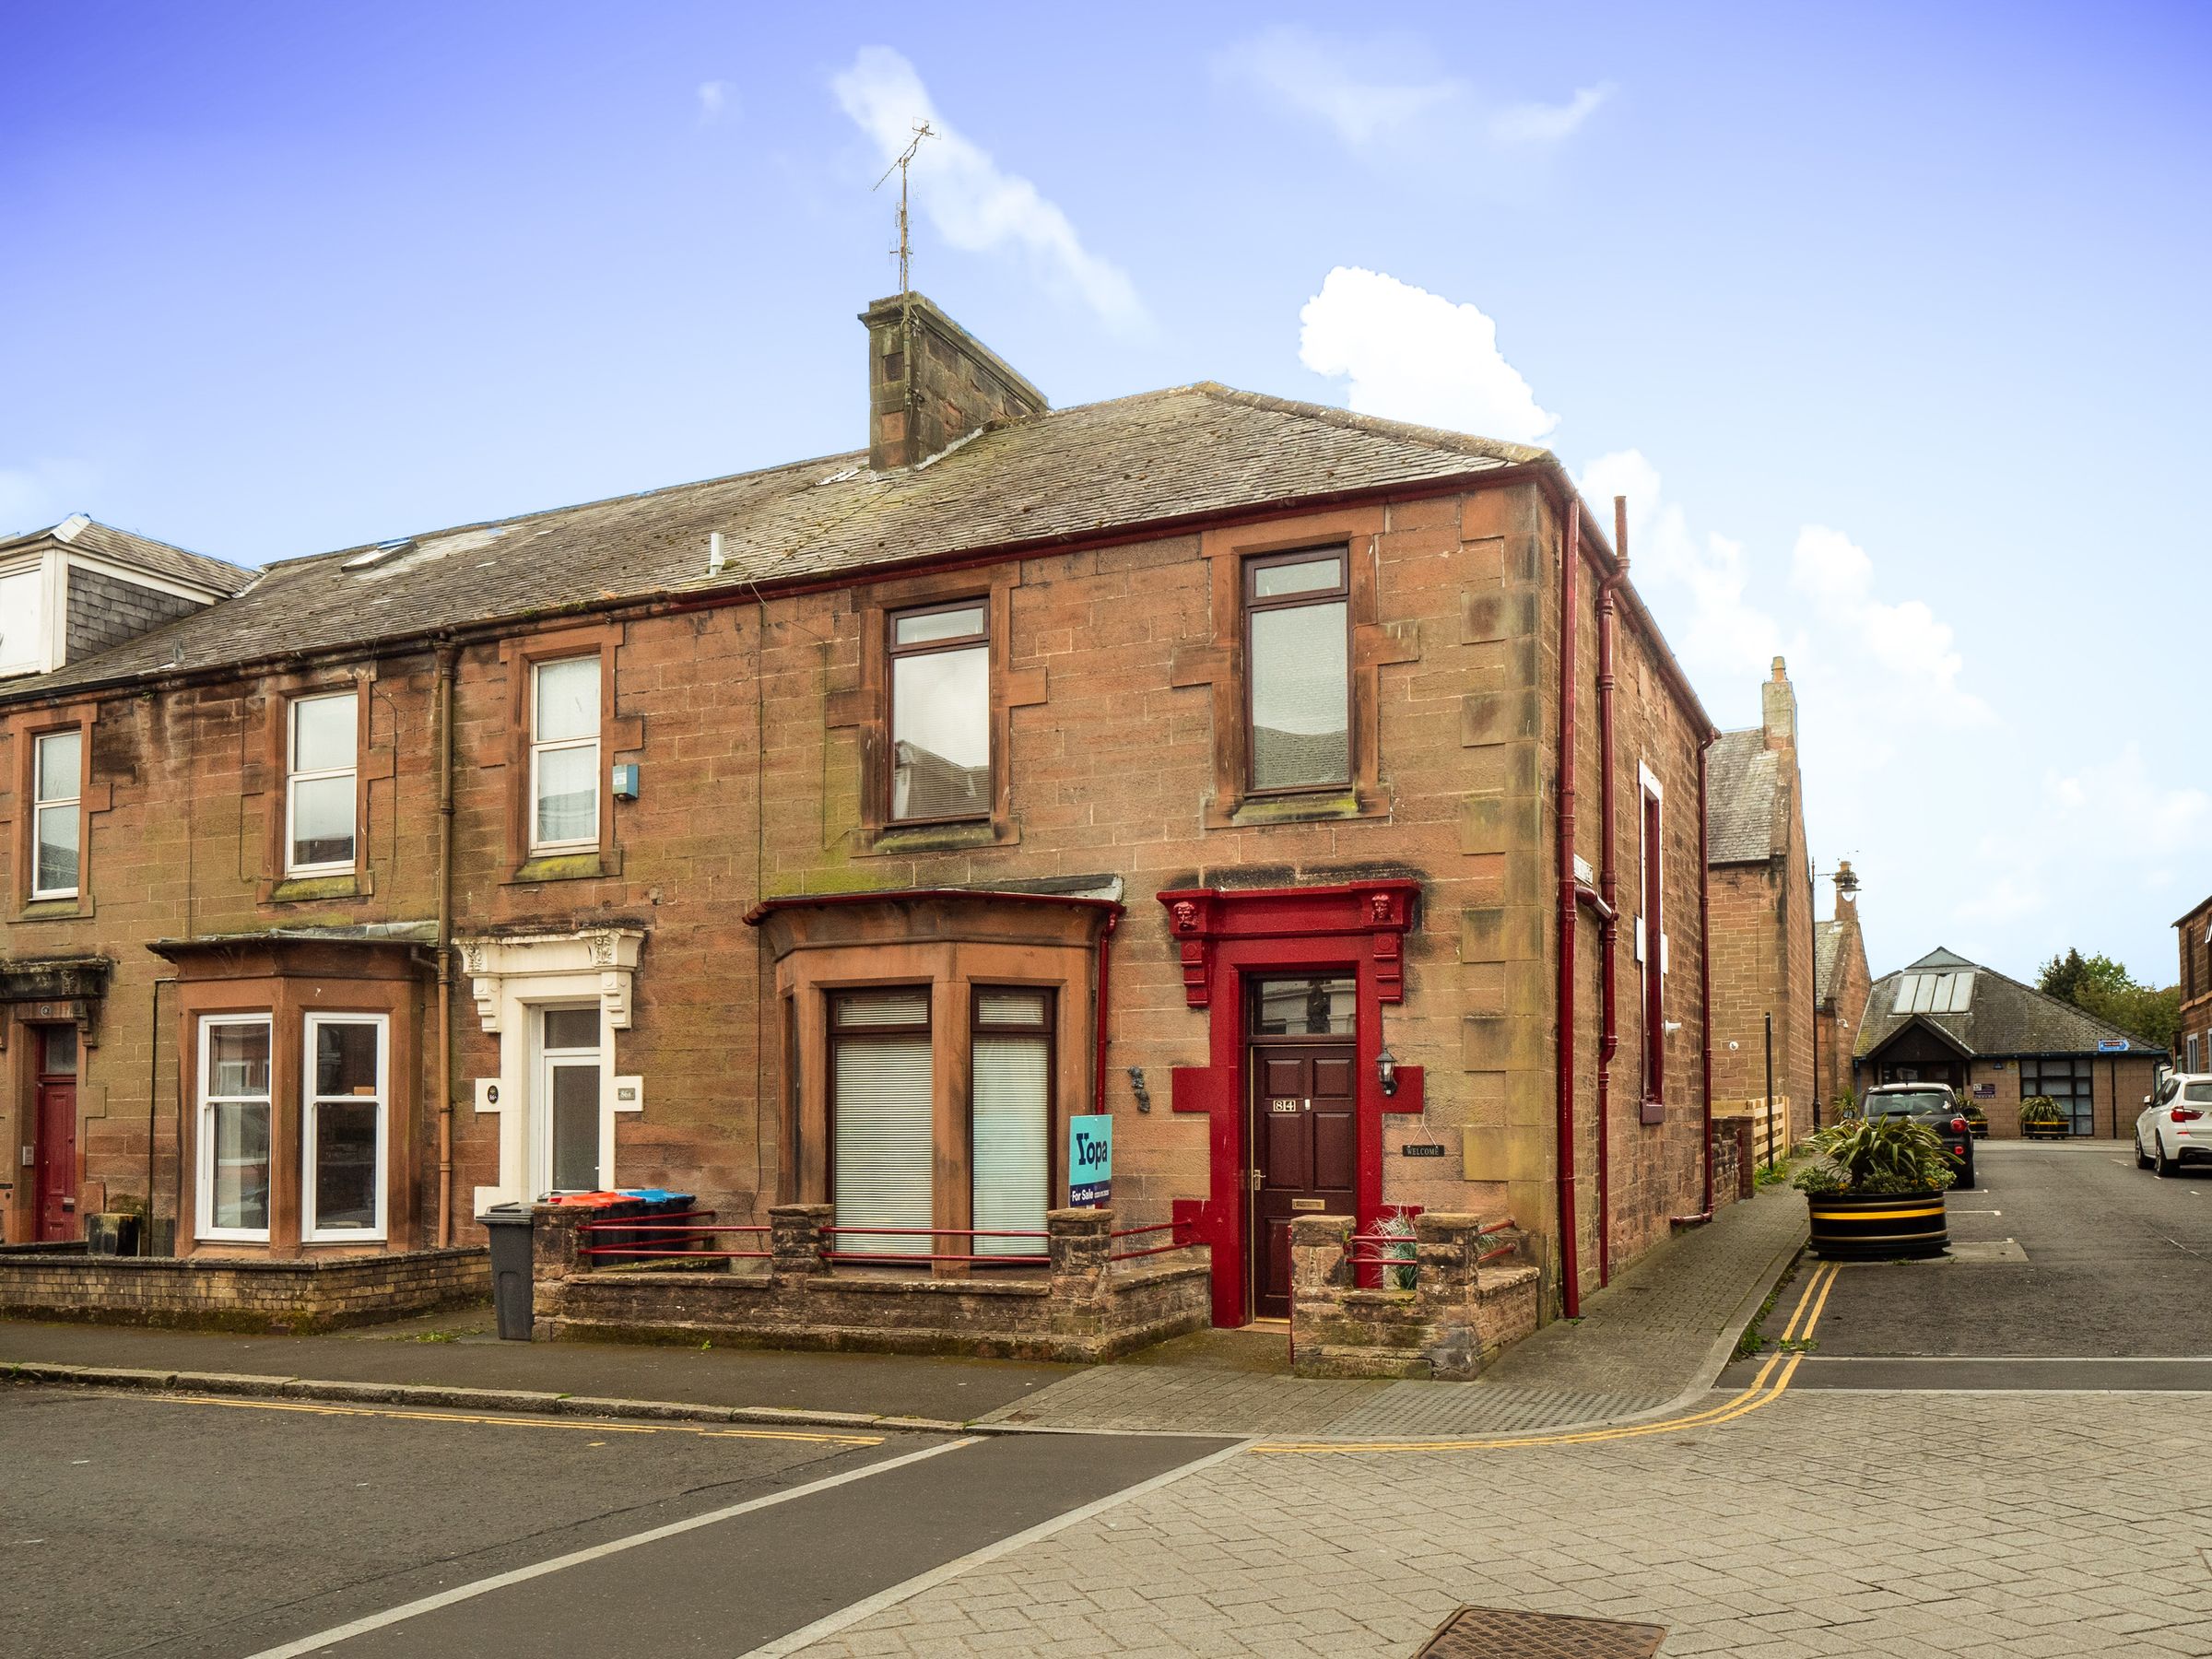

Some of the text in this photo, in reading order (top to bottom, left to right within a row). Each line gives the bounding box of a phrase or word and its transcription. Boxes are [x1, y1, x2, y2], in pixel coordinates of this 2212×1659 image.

[1276, 1100, 1294, 1111] 84
[1077, 1133, 1108, 1171] Yopa
[1406, 1147, 1440, 1156] WELCOME
[1072, 1190, 1082, 1202] For
[1081, 1188, 1094, 1201] Sale
